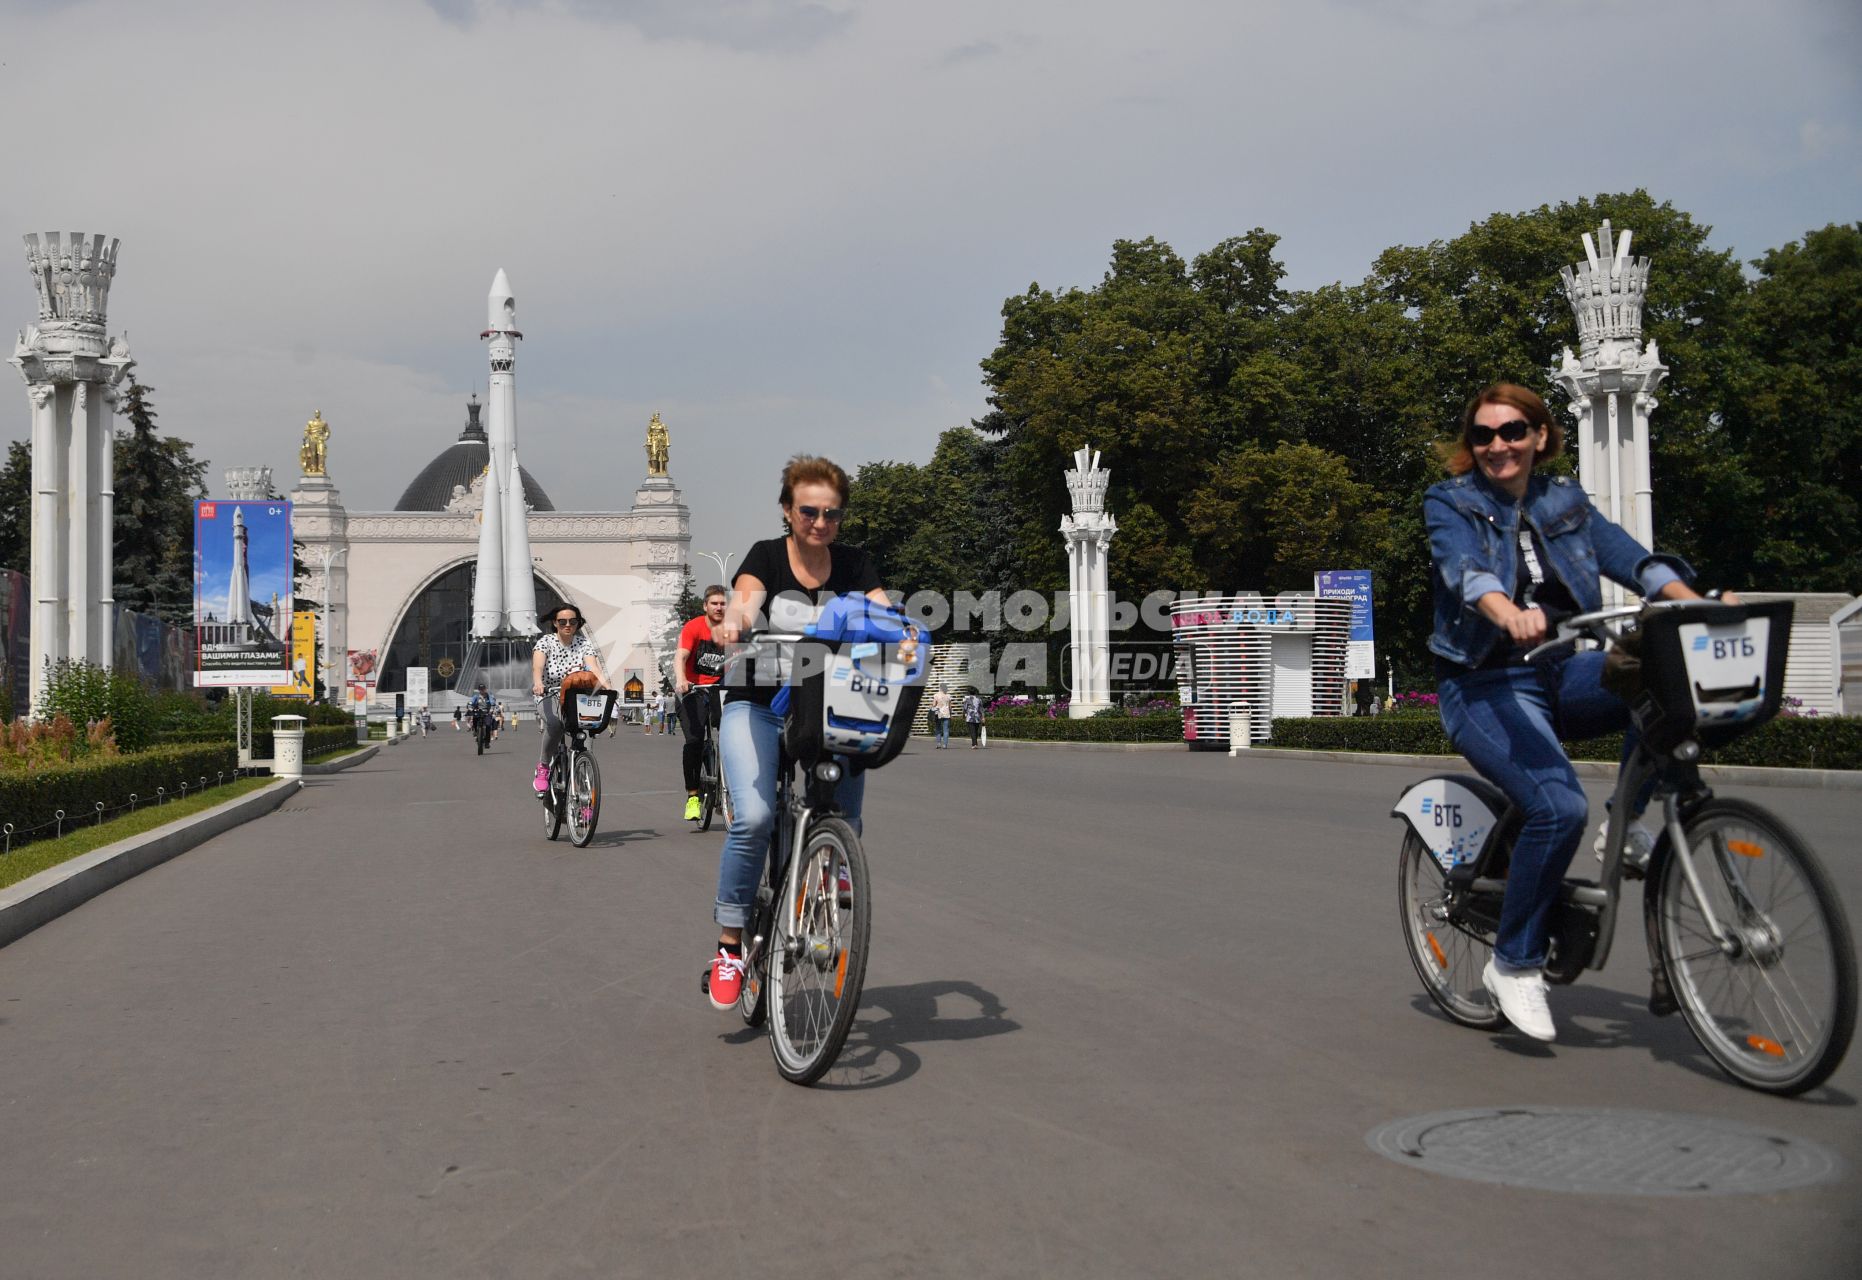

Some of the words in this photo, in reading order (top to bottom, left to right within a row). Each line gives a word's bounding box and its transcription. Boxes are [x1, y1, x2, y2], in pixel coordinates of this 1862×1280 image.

[268, 507, 282, 516] 0+
[1323, 588, 1356, 596] ПРИХОДИ
[1232, 609, 1295, 625] ВОДА
[1713, 637, 1755, 660] ВТБ
[240, 652, 281, 660] ГЛАЗАМИ.
[587, 699, 602, 708] ВТБ
[1434, 804, 1463, 828] ВТБ
